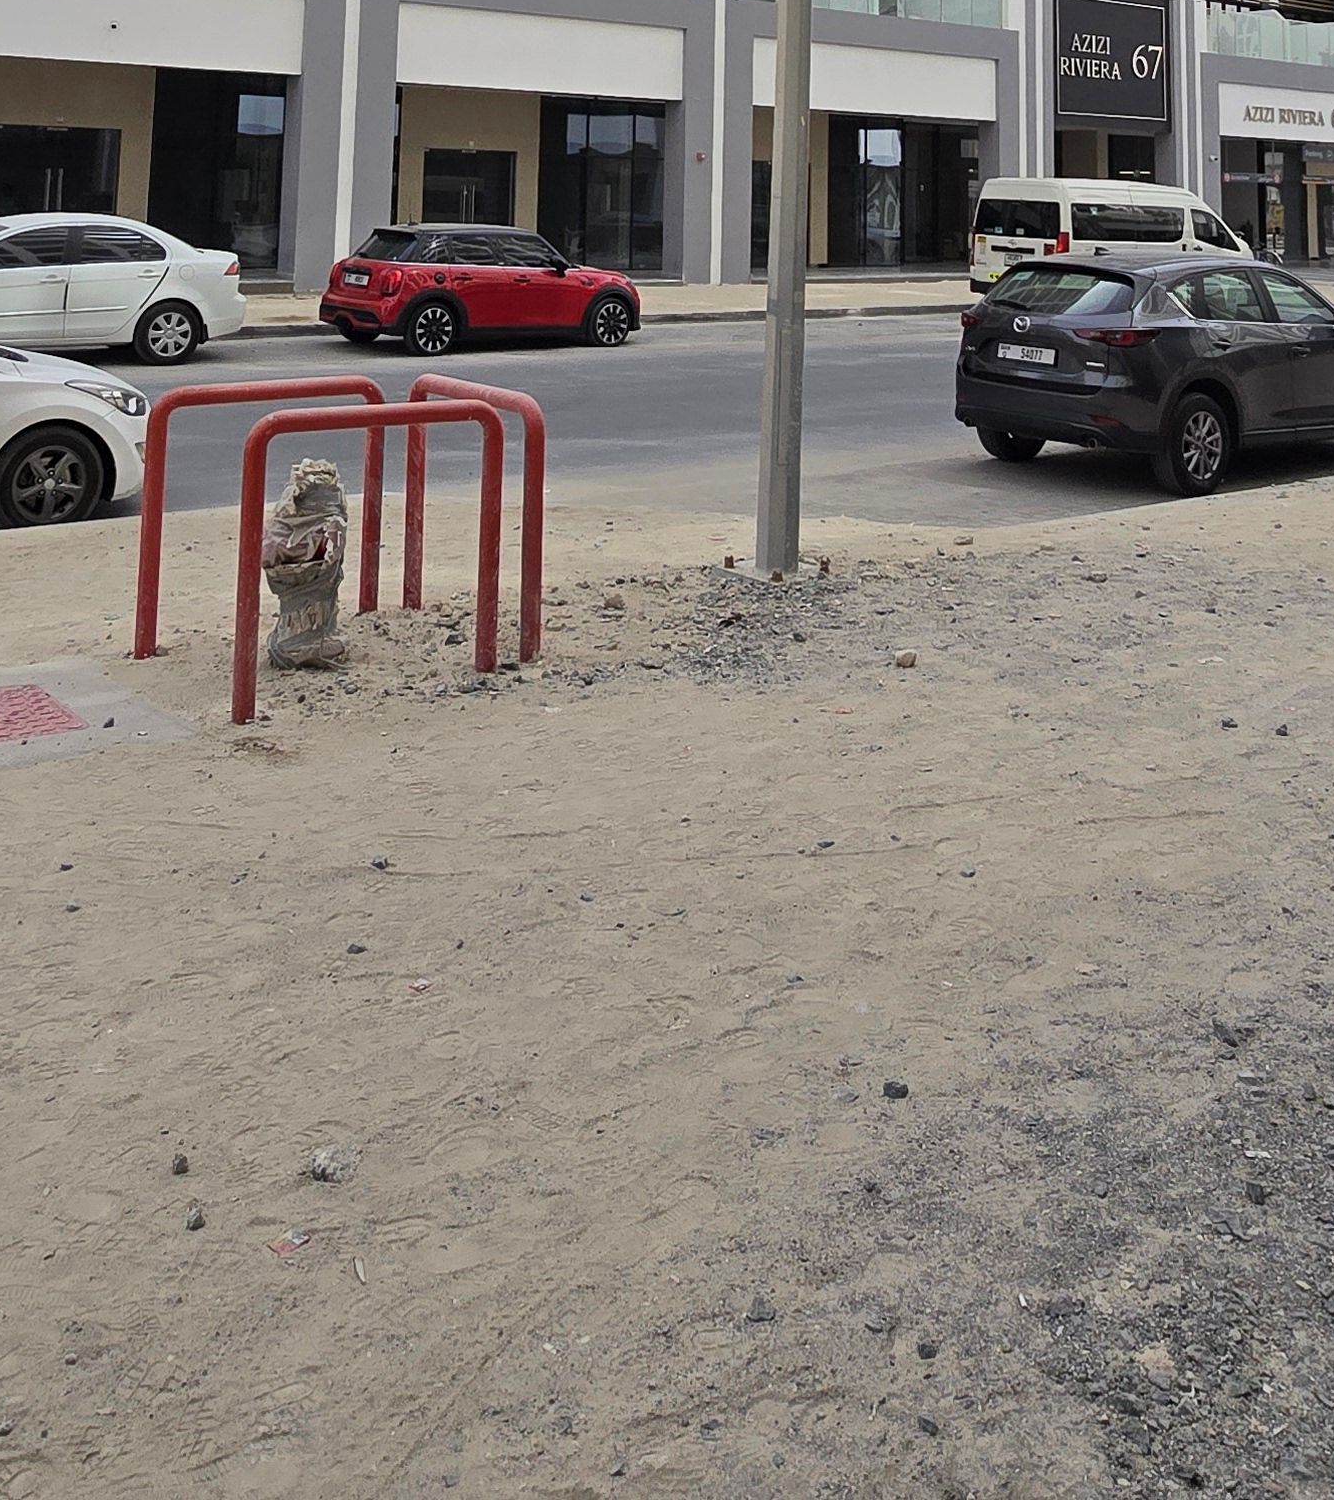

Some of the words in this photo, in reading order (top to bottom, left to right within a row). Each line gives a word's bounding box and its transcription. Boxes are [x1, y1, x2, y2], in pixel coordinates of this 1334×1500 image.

[1071, 33, 1111, 55] AZIZI
[1060, 56, 1122, 80] RIVIERA
[1132, 44, 1163, 80] 67
[1243, 105, 1275, 123] AZIZI
[1279, 107, 1325, 127] RIVIERA
[1020, 347, 1044, 361] 54077
